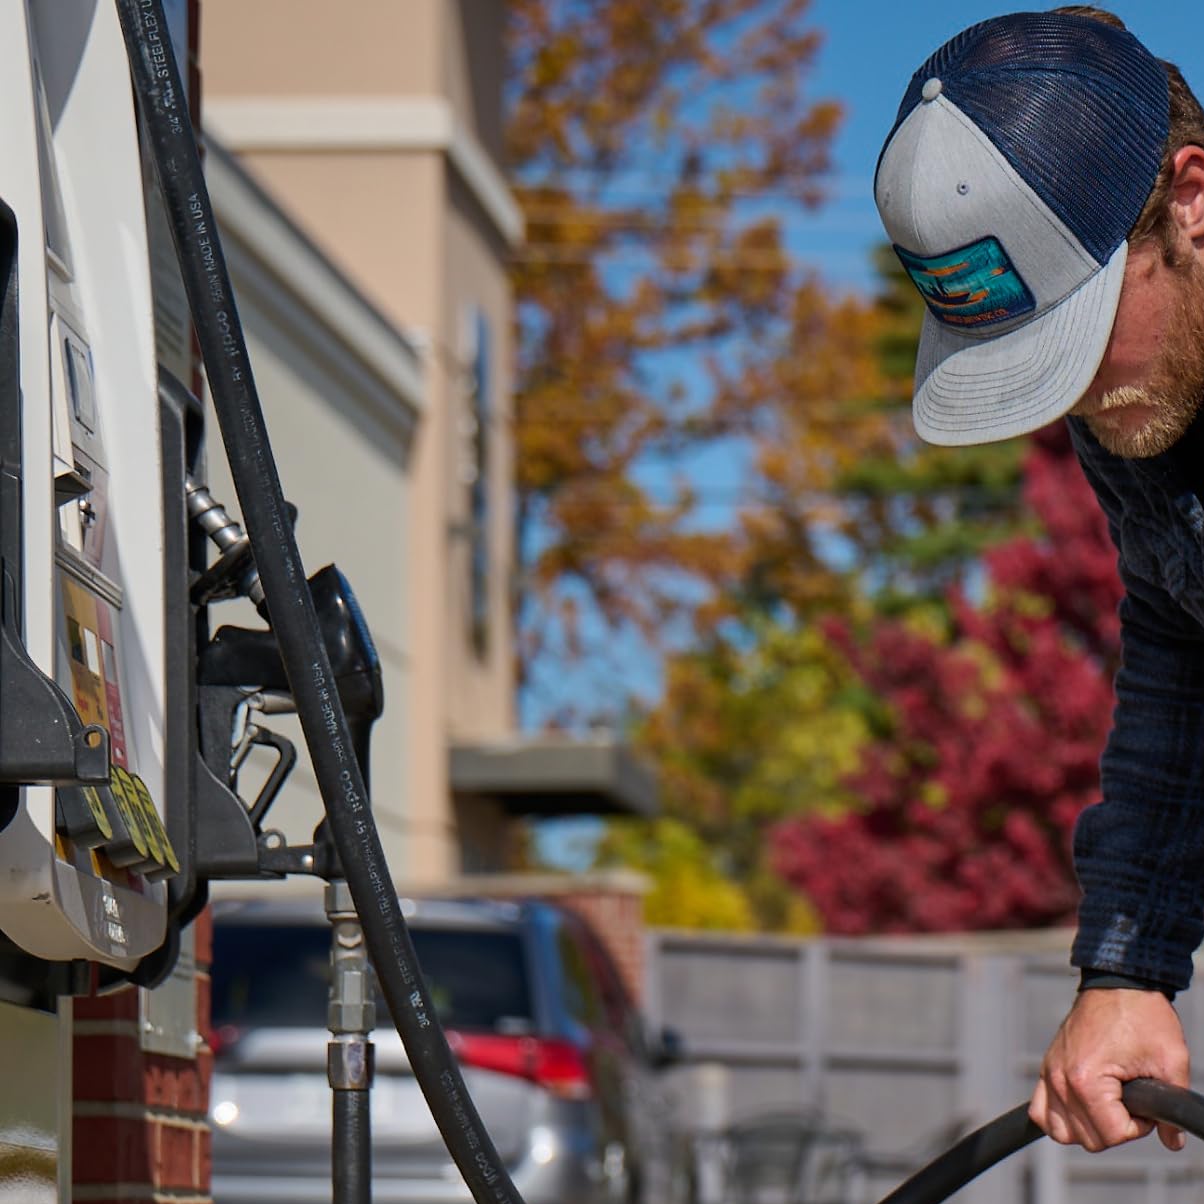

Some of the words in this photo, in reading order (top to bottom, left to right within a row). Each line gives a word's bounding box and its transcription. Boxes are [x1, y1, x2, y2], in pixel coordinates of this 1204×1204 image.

[145, 11, 171, 79] STEELFLEX
[186, 192, 204, 219] USA
[194, 220, 207, 235] IN
[199, 236, 216, 272] MADE
[309, 661, 326, 686] USA
[320, 701, 340, 734] MADE
